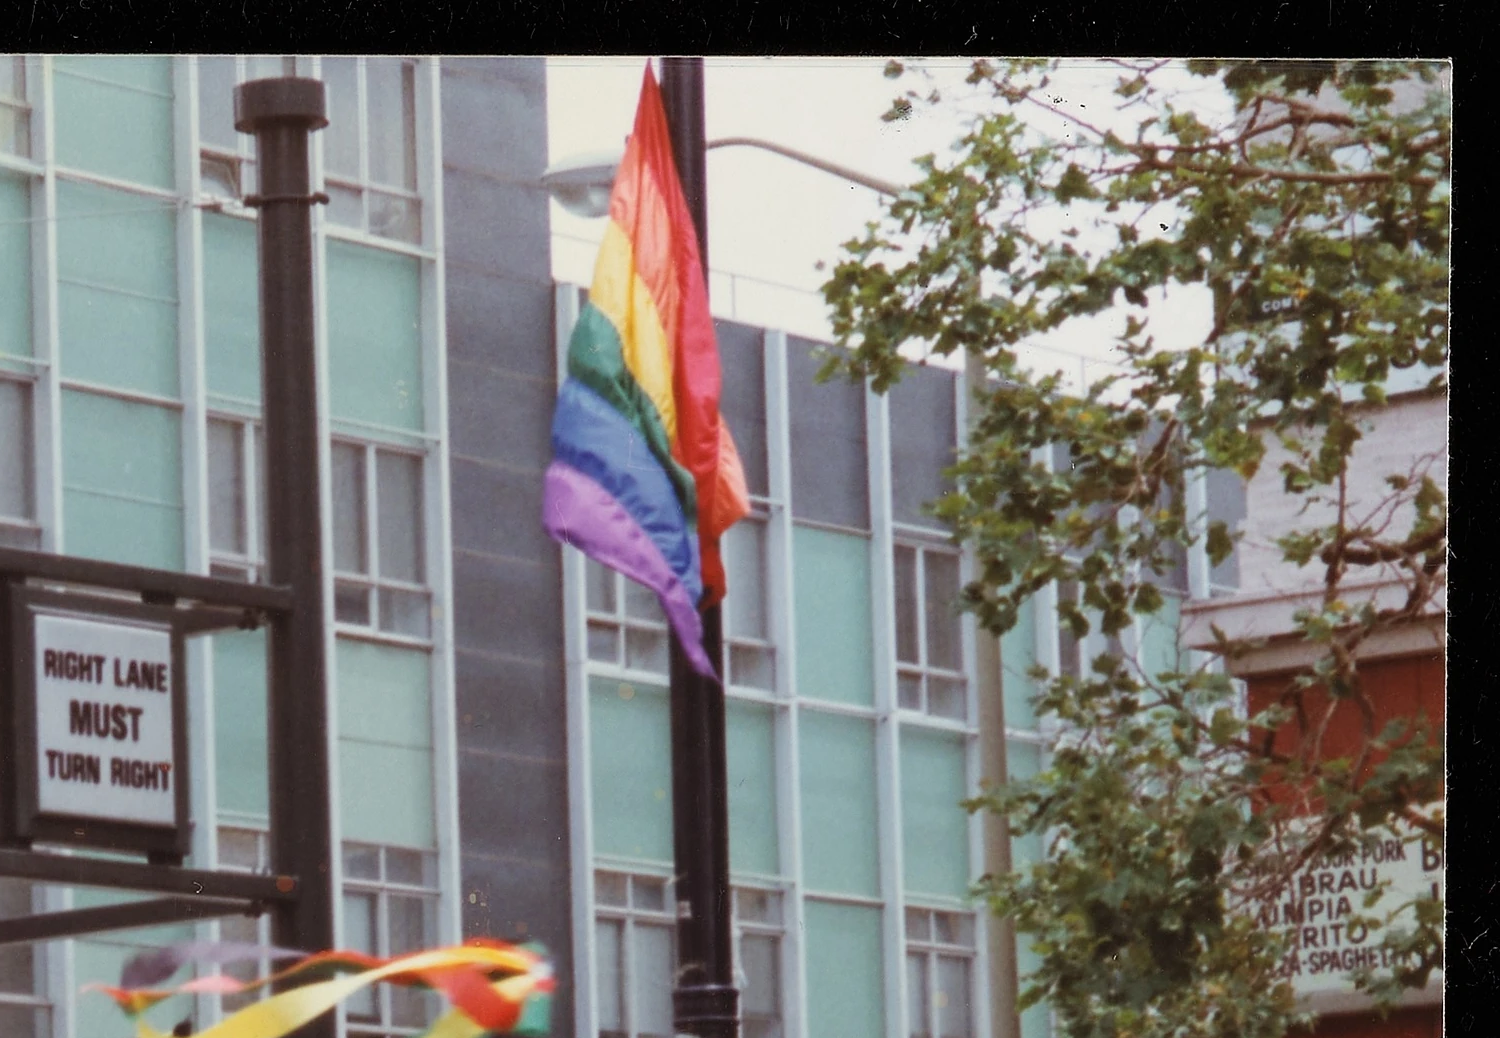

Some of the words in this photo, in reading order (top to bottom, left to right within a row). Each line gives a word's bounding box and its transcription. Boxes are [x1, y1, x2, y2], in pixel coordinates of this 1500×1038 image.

[44, 648, 106, 685] RIGHT
[114, 657, 168, 693] LANE
[69, 699, 143, 743] MUST
[45, 749, 101, 785] TURN
[111, 757, 171, 792] RIGHT
